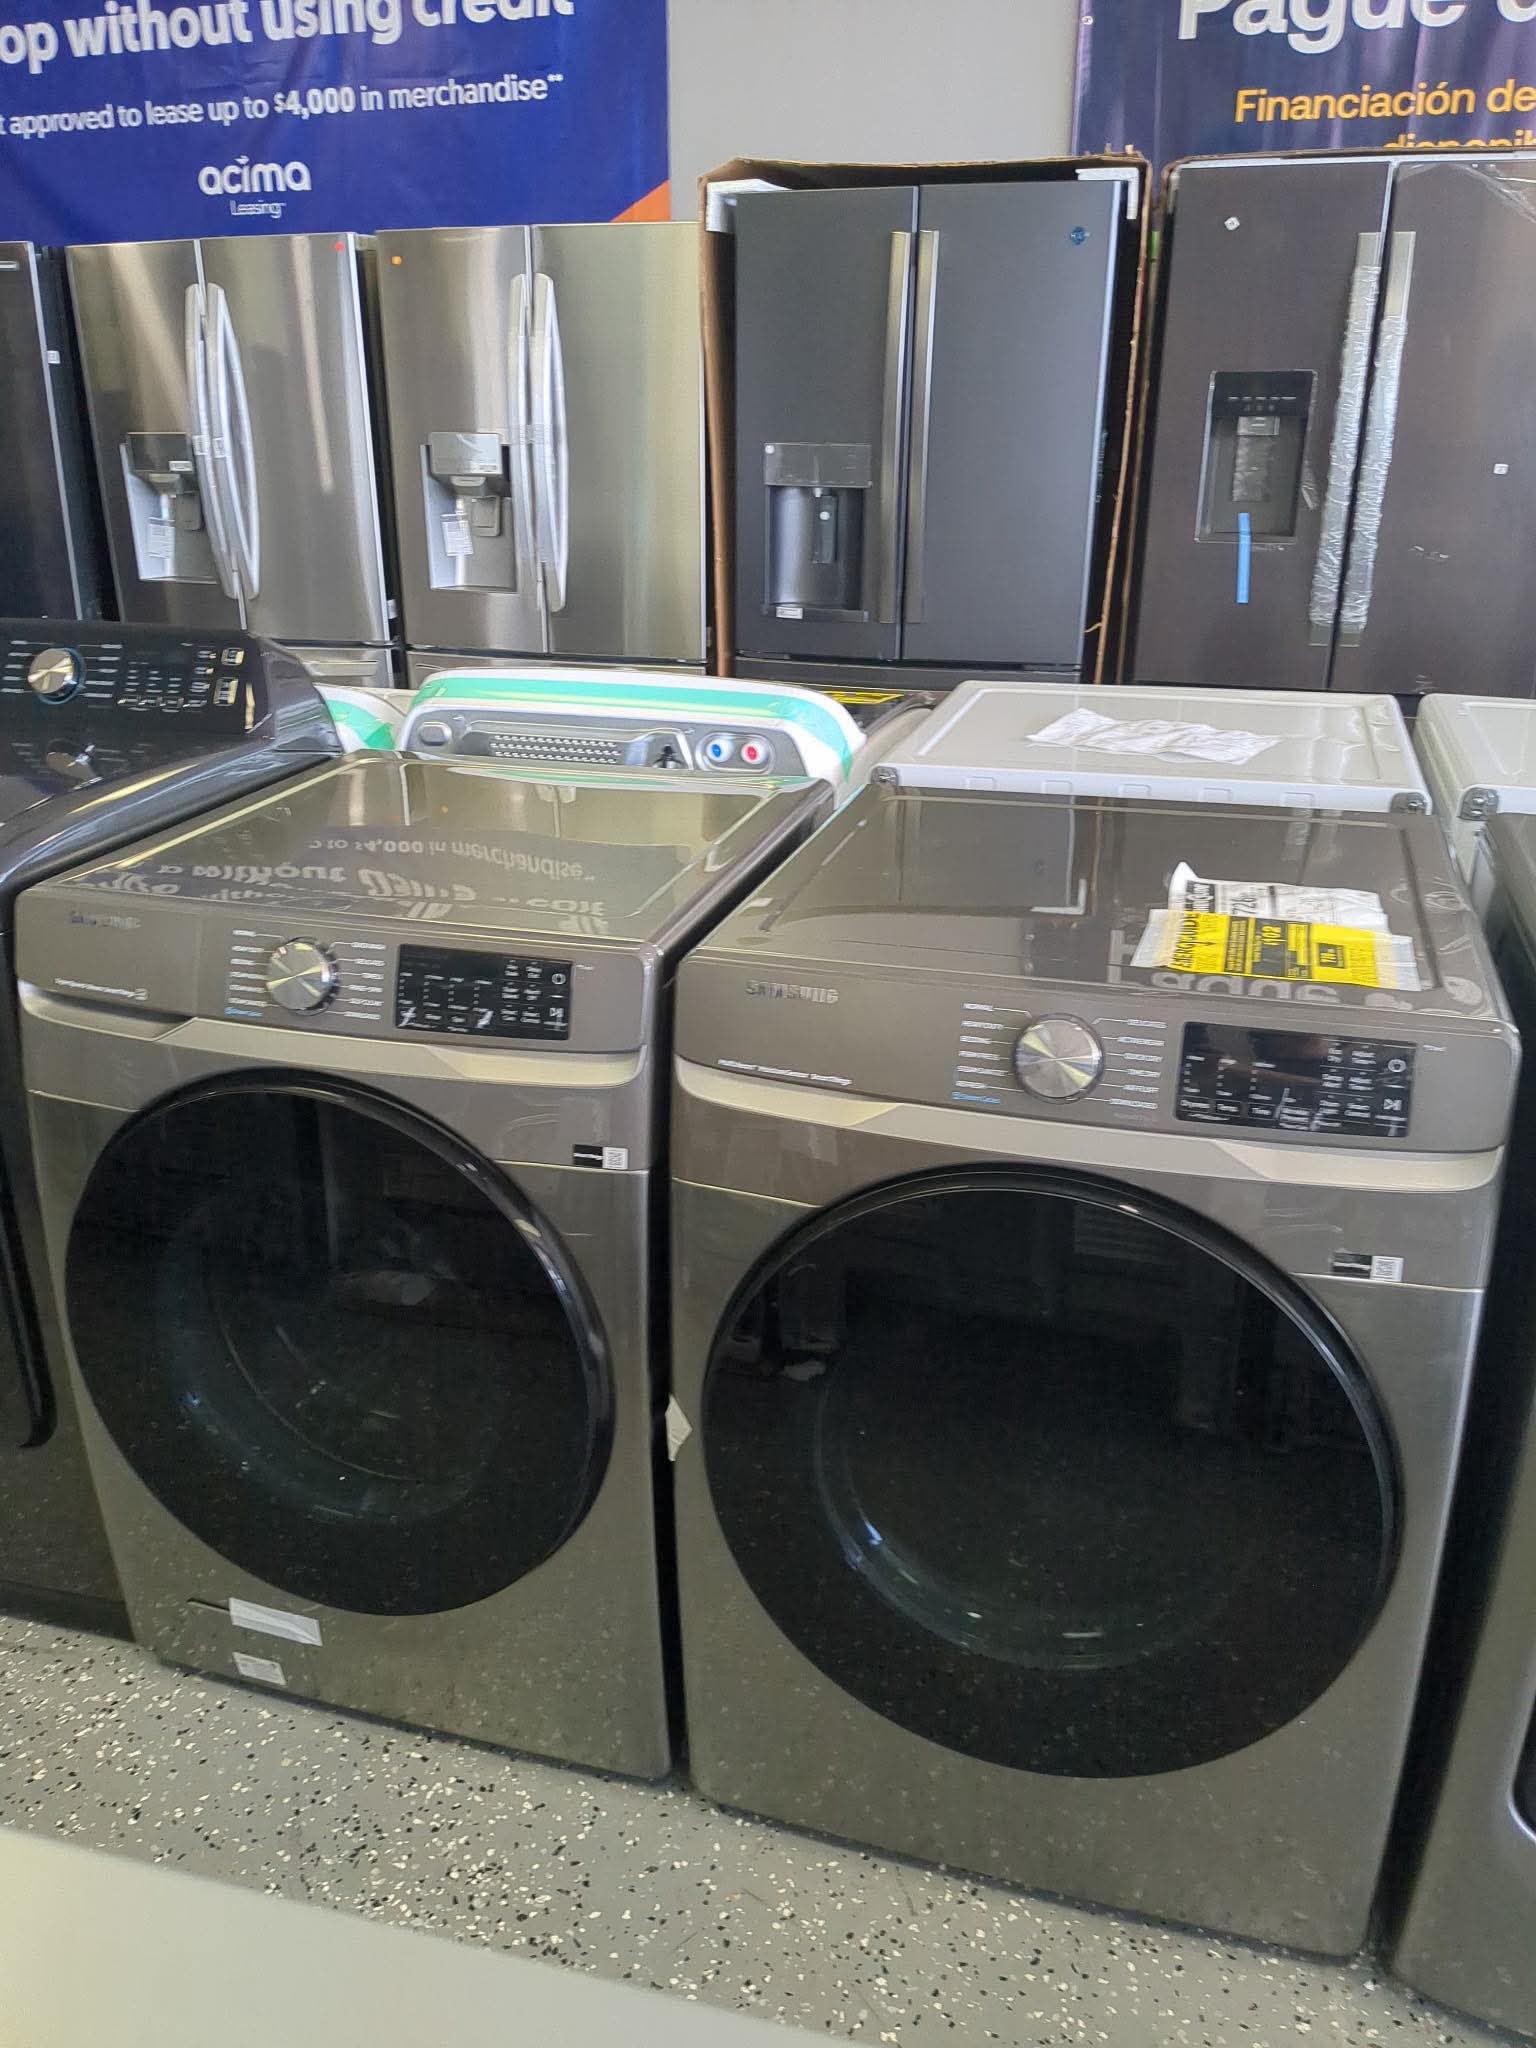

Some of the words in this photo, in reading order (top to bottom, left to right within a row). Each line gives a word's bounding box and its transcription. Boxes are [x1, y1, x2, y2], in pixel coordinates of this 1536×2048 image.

[63, 0, 253, 58] without
[260, 0, 401, 45] using
[412, 0, 575, 27] cre
[1178, 0, 1466, 54] Pague
[9, 104, 115, 140] approved
[117, 105, 142, 127] to
[145, 101, 204, 125] lease
[208, 101, 240, 127] up
[243, 96, 269, 119] to
[273, 87, 356, 120] $4,000
[360, 86, 384, 111] in
[1234, 81, 1476, 123] Financiación
[1487, 78, 1536, 113] de
[198, 155, 312, 195] acima
[745, 979, 839, 1004] SAMSUNG
